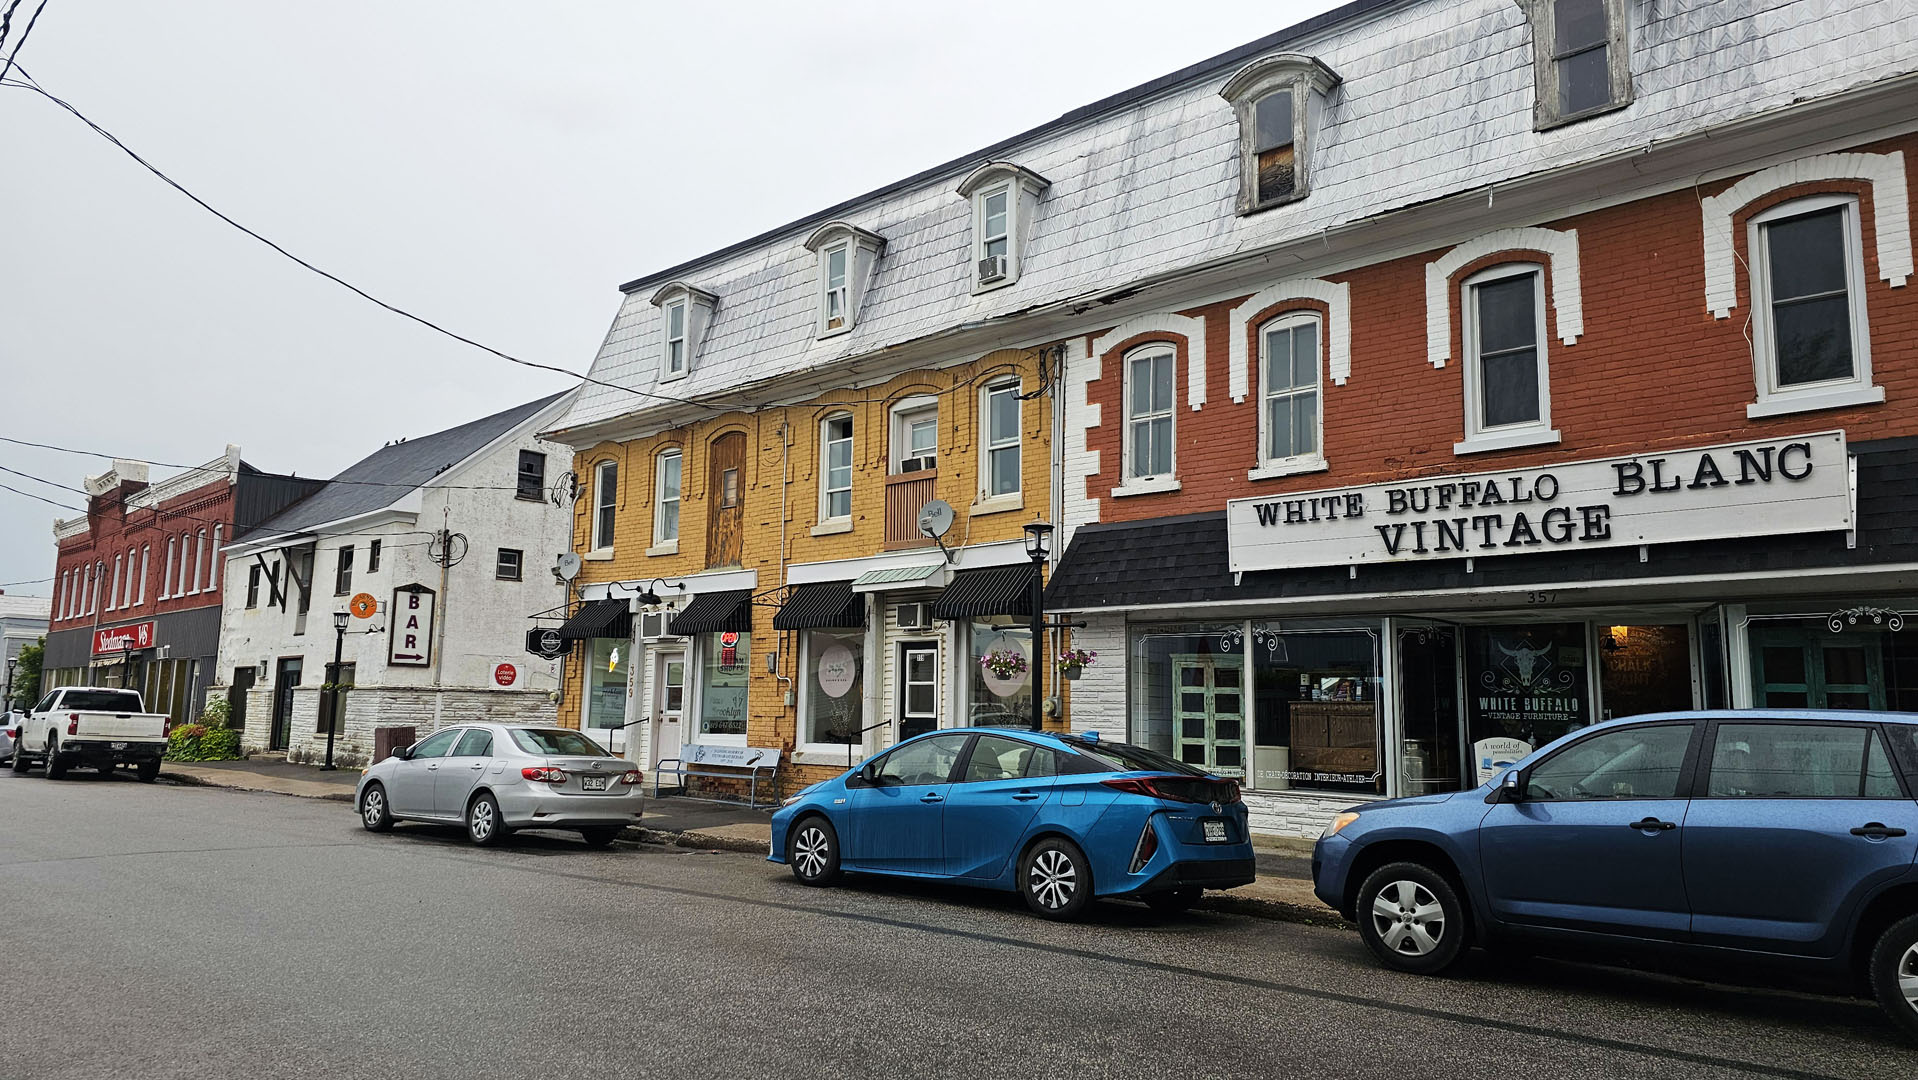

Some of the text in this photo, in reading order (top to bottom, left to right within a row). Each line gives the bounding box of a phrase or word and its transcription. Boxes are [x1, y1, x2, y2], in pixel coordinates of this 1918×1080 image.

[1253, 442, 1814, 527] WHITE BUFFALO BLANC
[1373, 504, 1612, 556] VINTAGE
[405, 595, 420, 649] BAR
[98, 630, 131, 651] Stedma
[712, 706, 741, 719] ooklyn
[1479, 697, 1578, 712] WHITE BUFFALO
[1482, 741, 1521, 750] A world of
